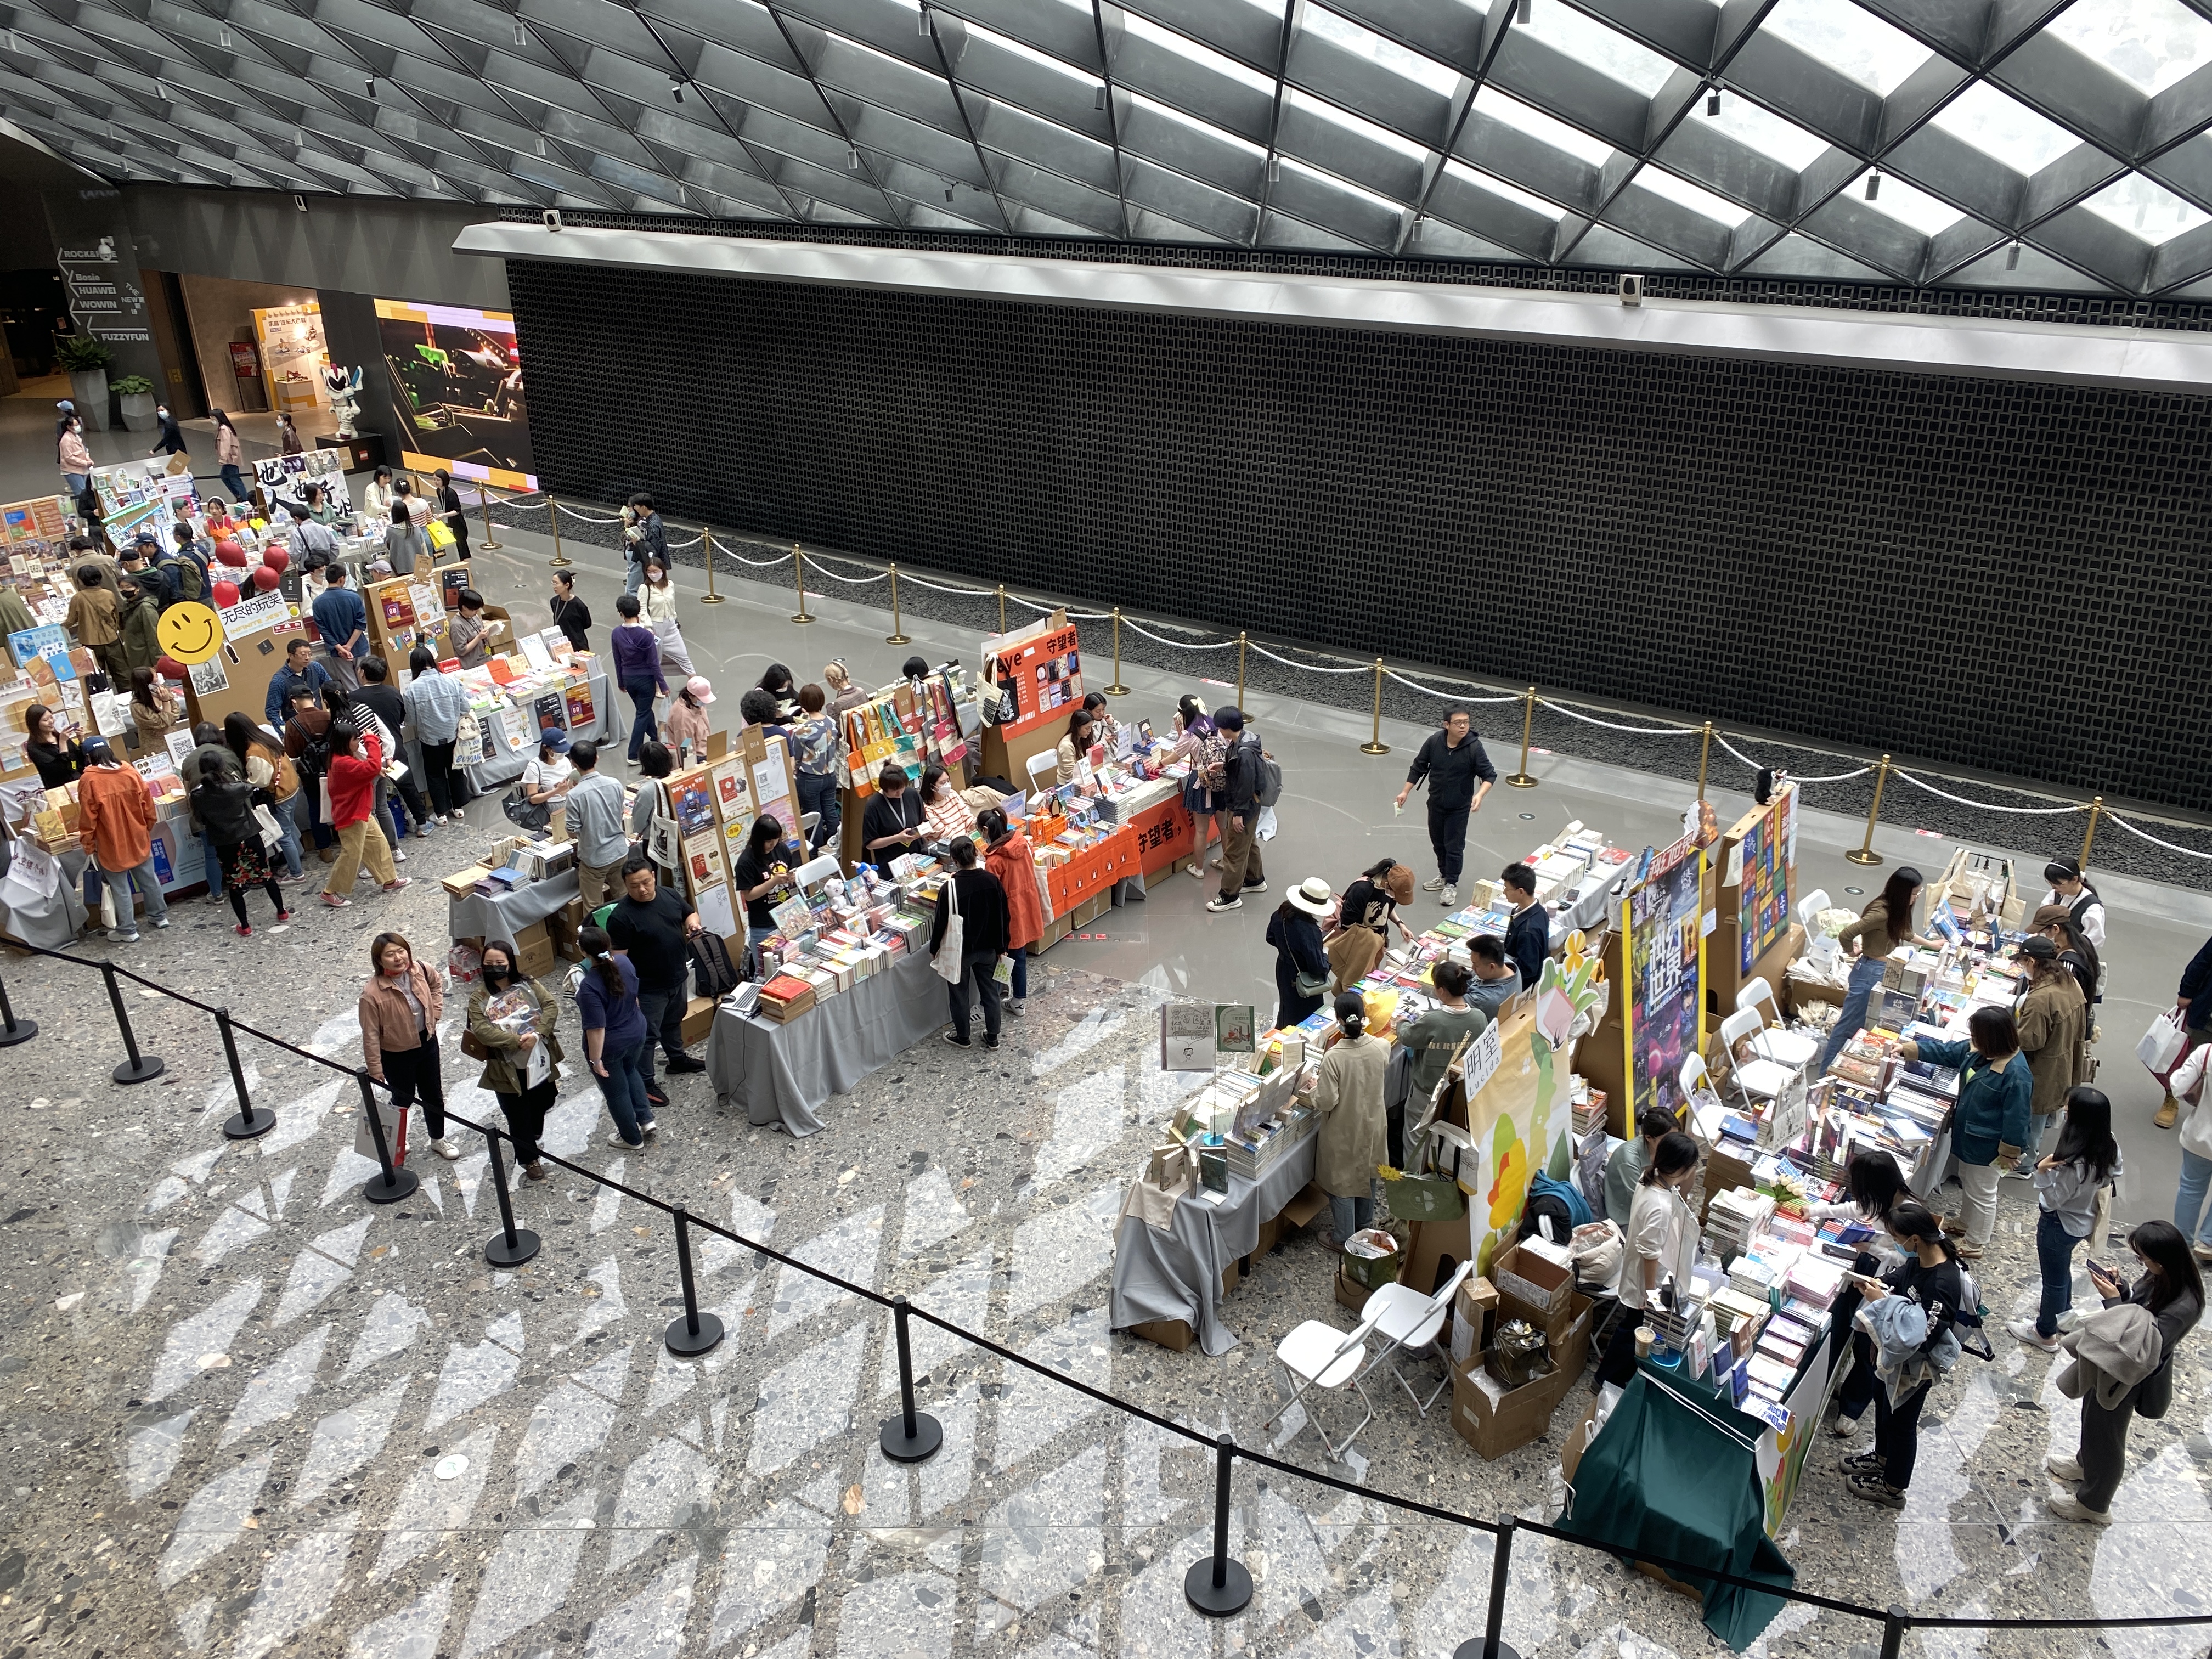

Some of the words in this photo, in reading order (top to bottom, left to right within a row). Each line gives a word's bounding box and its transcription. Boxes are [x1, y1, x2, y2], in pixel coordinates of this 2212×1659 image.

[126, 282, 140, 297] THE
[221, 592, 283, 625] 无尽的玩笑
[229, 619, 263, 635] INFINITE
[264, 610, 284, 622] JEST
[1046, 630, 1076, 654] 守望者
[1647, 832, 1693, 882] 科幻世界
[1649, 917, 1682, 974] 科幻
[1649, 950, 1682, 1006] 世界
[1466, 1026, 1498, 1079] 明室
[1469, 1057, 1499, 1097] Lucida
